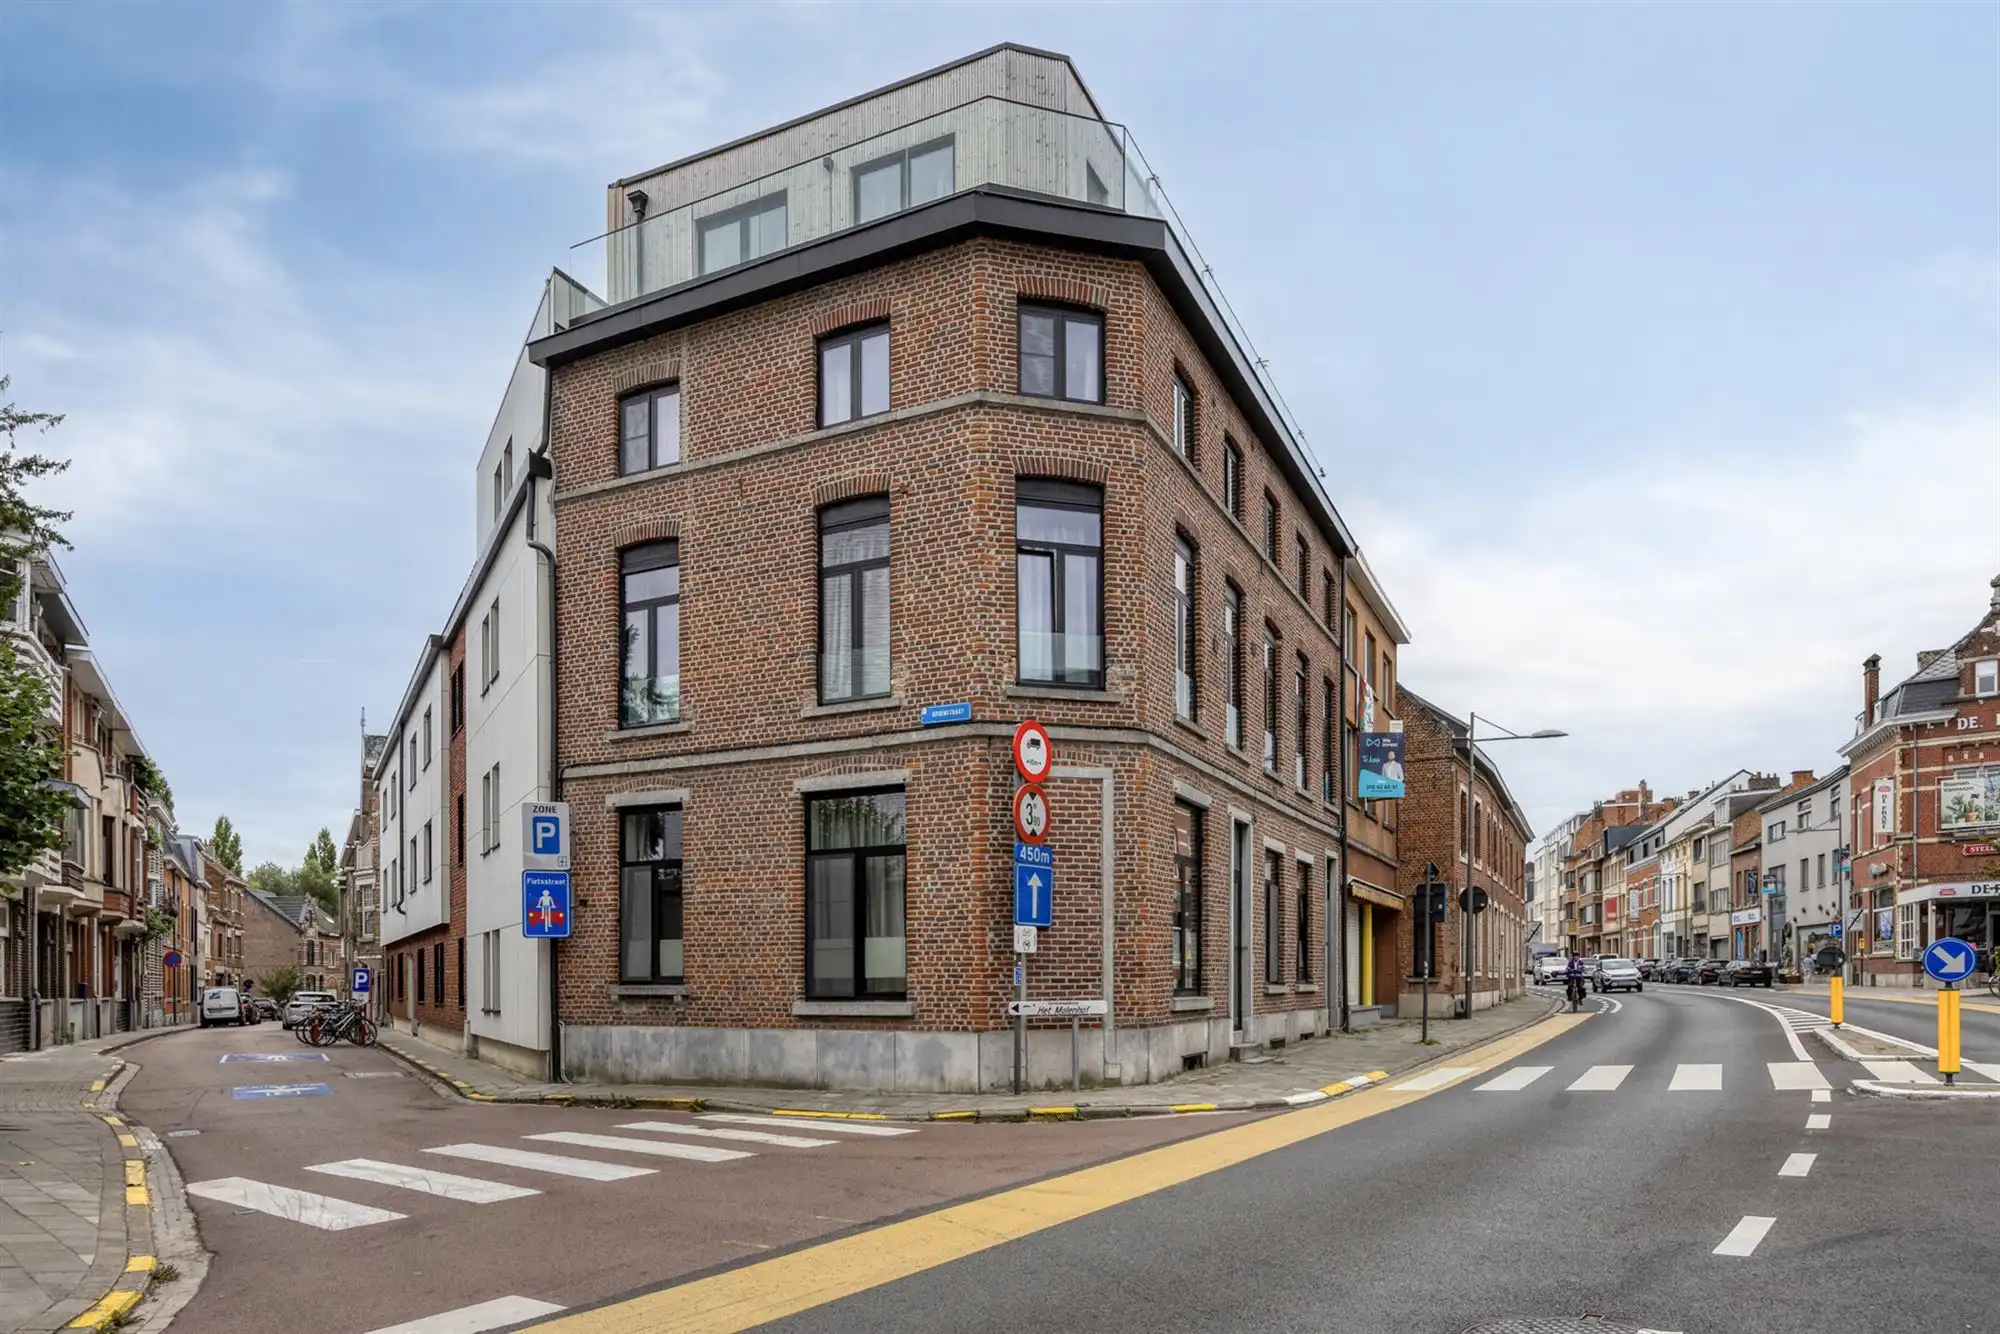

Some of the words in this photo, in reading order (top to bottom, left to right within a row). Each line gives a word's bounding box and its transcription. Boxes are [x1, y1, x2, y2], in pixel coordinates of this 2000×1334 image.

[1957, 716, 1979, 730] DE
[532, 805, 558, 814] ZONE
[536, 822, 556, 849] P
[1019, 845, 1050, 864] 450m
[1970, 845, 1997, 853] STELL
[526, 877, 567, 885] Fietsstraat
[1971, 884, 1990, 895] DE
[354, 971, 368, 989] P
